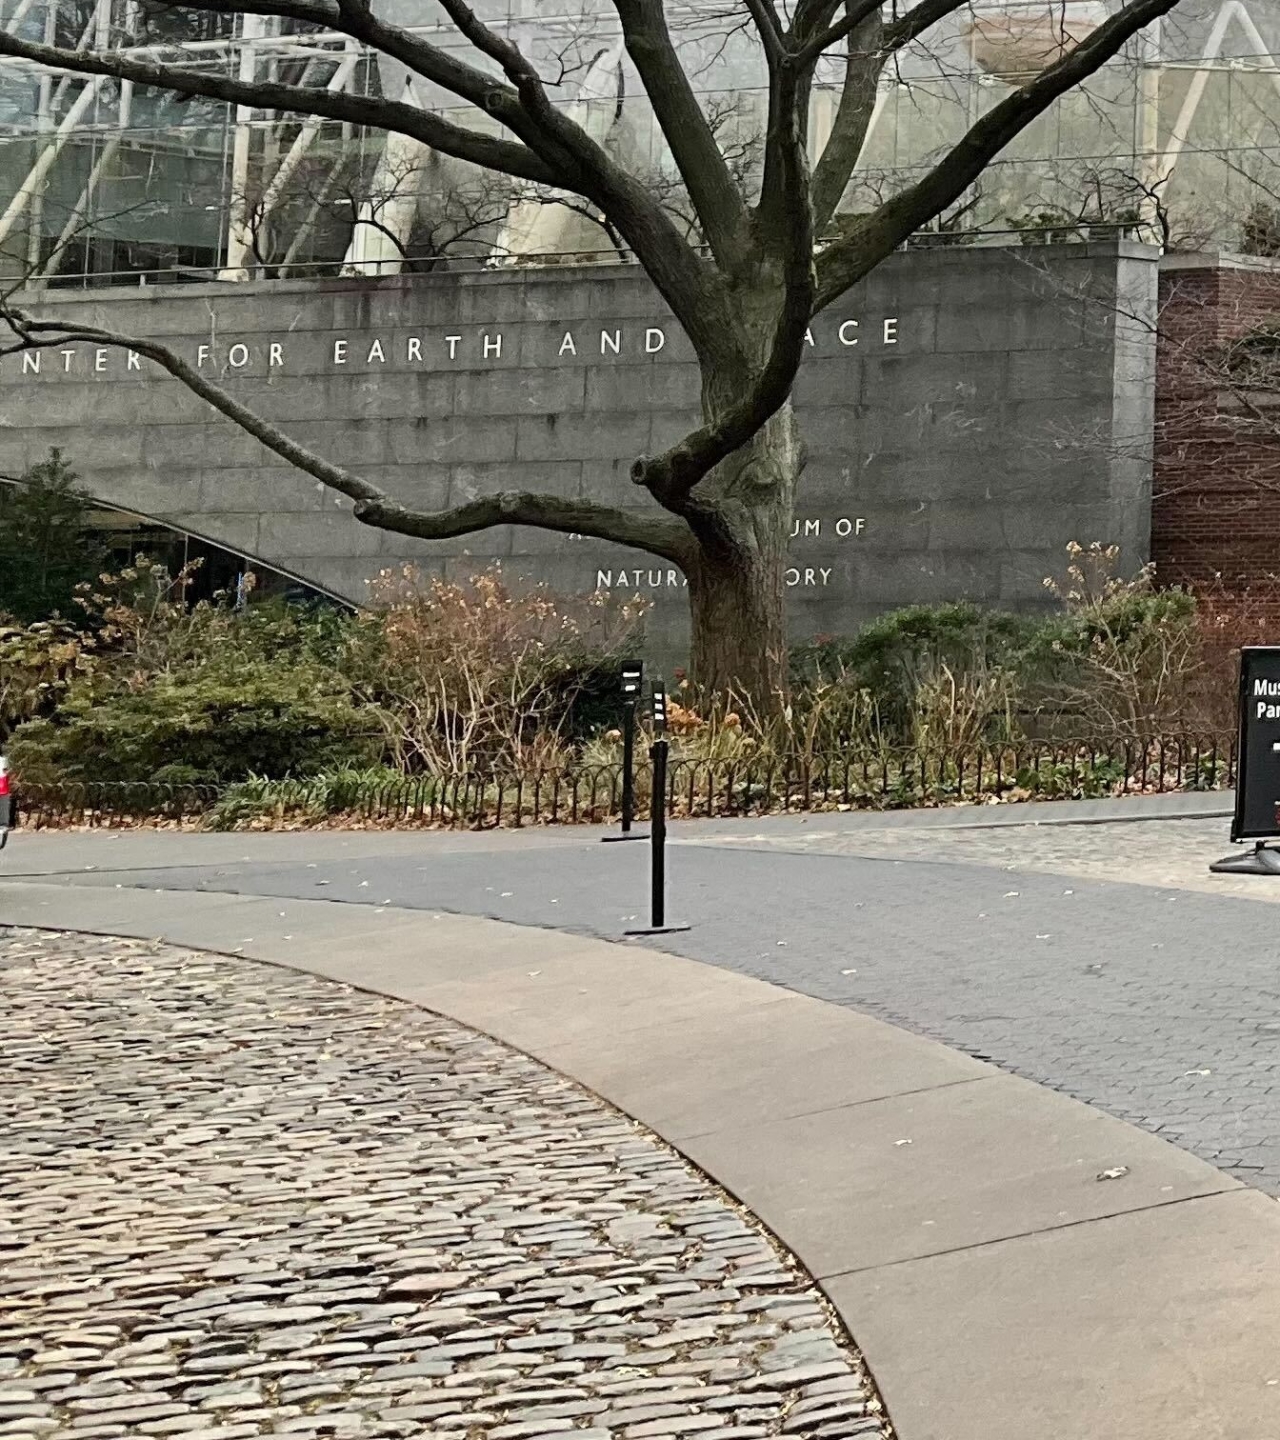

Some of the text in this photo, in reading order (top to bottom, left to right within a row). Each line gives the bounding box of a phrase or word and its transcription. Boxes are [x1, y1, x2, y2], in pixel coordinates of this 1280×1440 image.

[21, 348, 141, 375] NTER
[197, 342, 284, 368] FOR
[333, 333, 502, 364] EARTH
[557, 327, 665, 357] AND
[835, 517, 866, 537] OF
